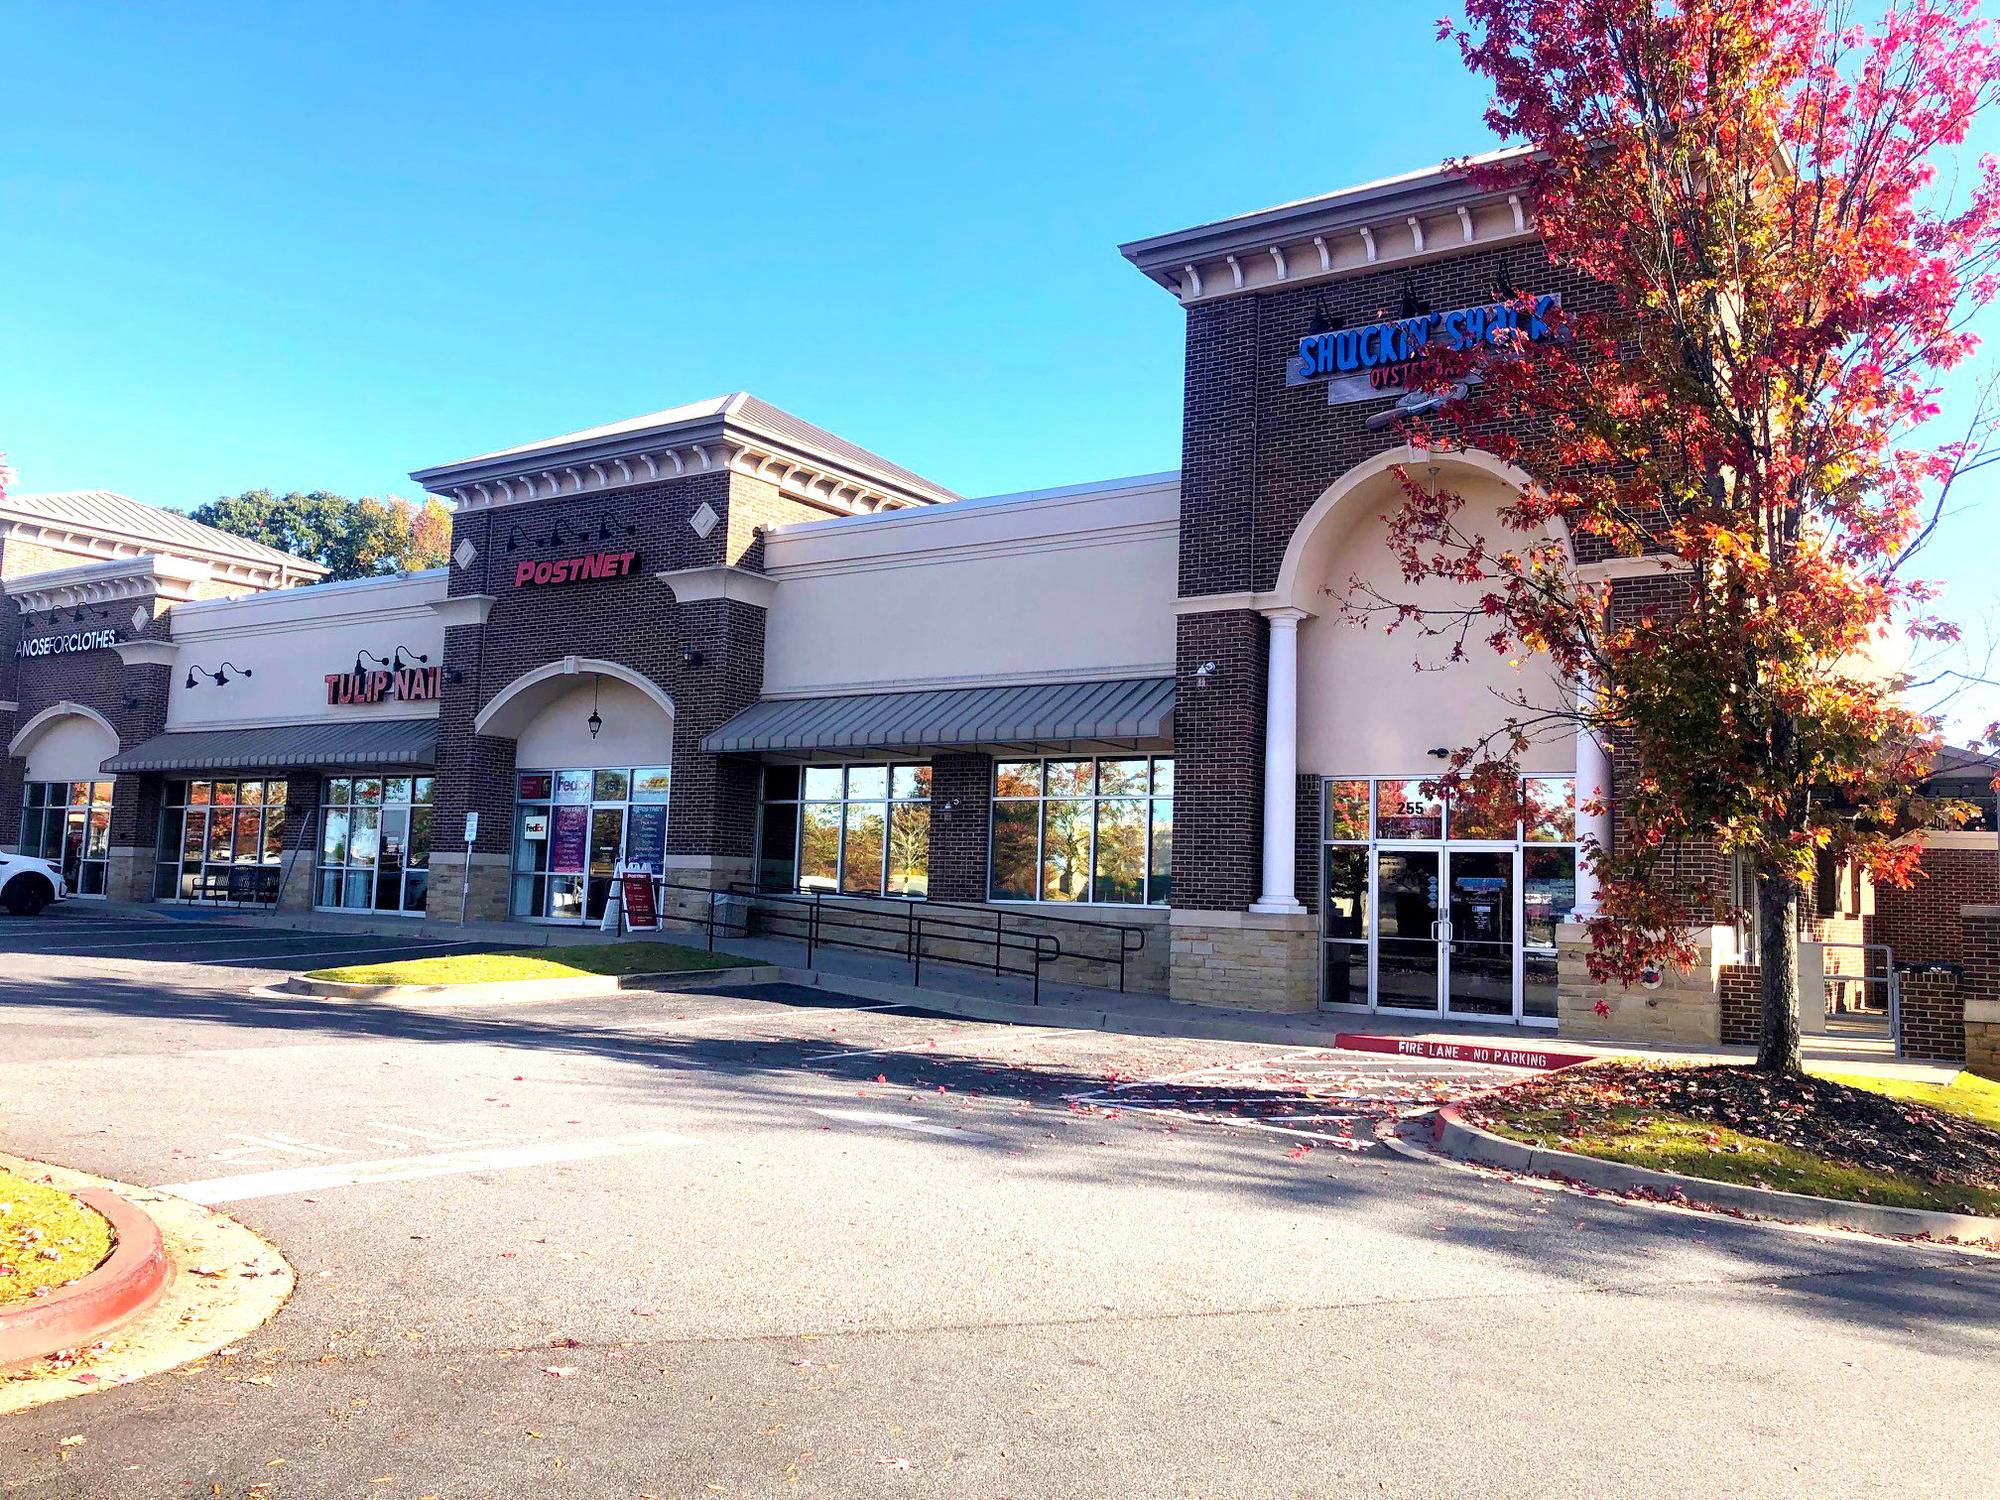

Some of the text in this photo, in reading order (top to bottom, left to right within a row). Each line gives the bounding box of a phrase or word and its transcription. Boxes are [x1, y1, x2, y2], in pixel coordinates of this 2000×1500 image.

[1298, 311, 1442, 377] SHUCKIN'
[324, 670, 388, 705] TULIP
[1397, 801, 1424, 815] 255
[526, 823, 544, 832] FedEx
[1398, 1041, 1424, 1055] FIRE
[1429, 1043, 1460, 1059] LANE
[1473, 1048, 1489, 1062] NO
[1494, 1050, 1547, 1067] PARKING
